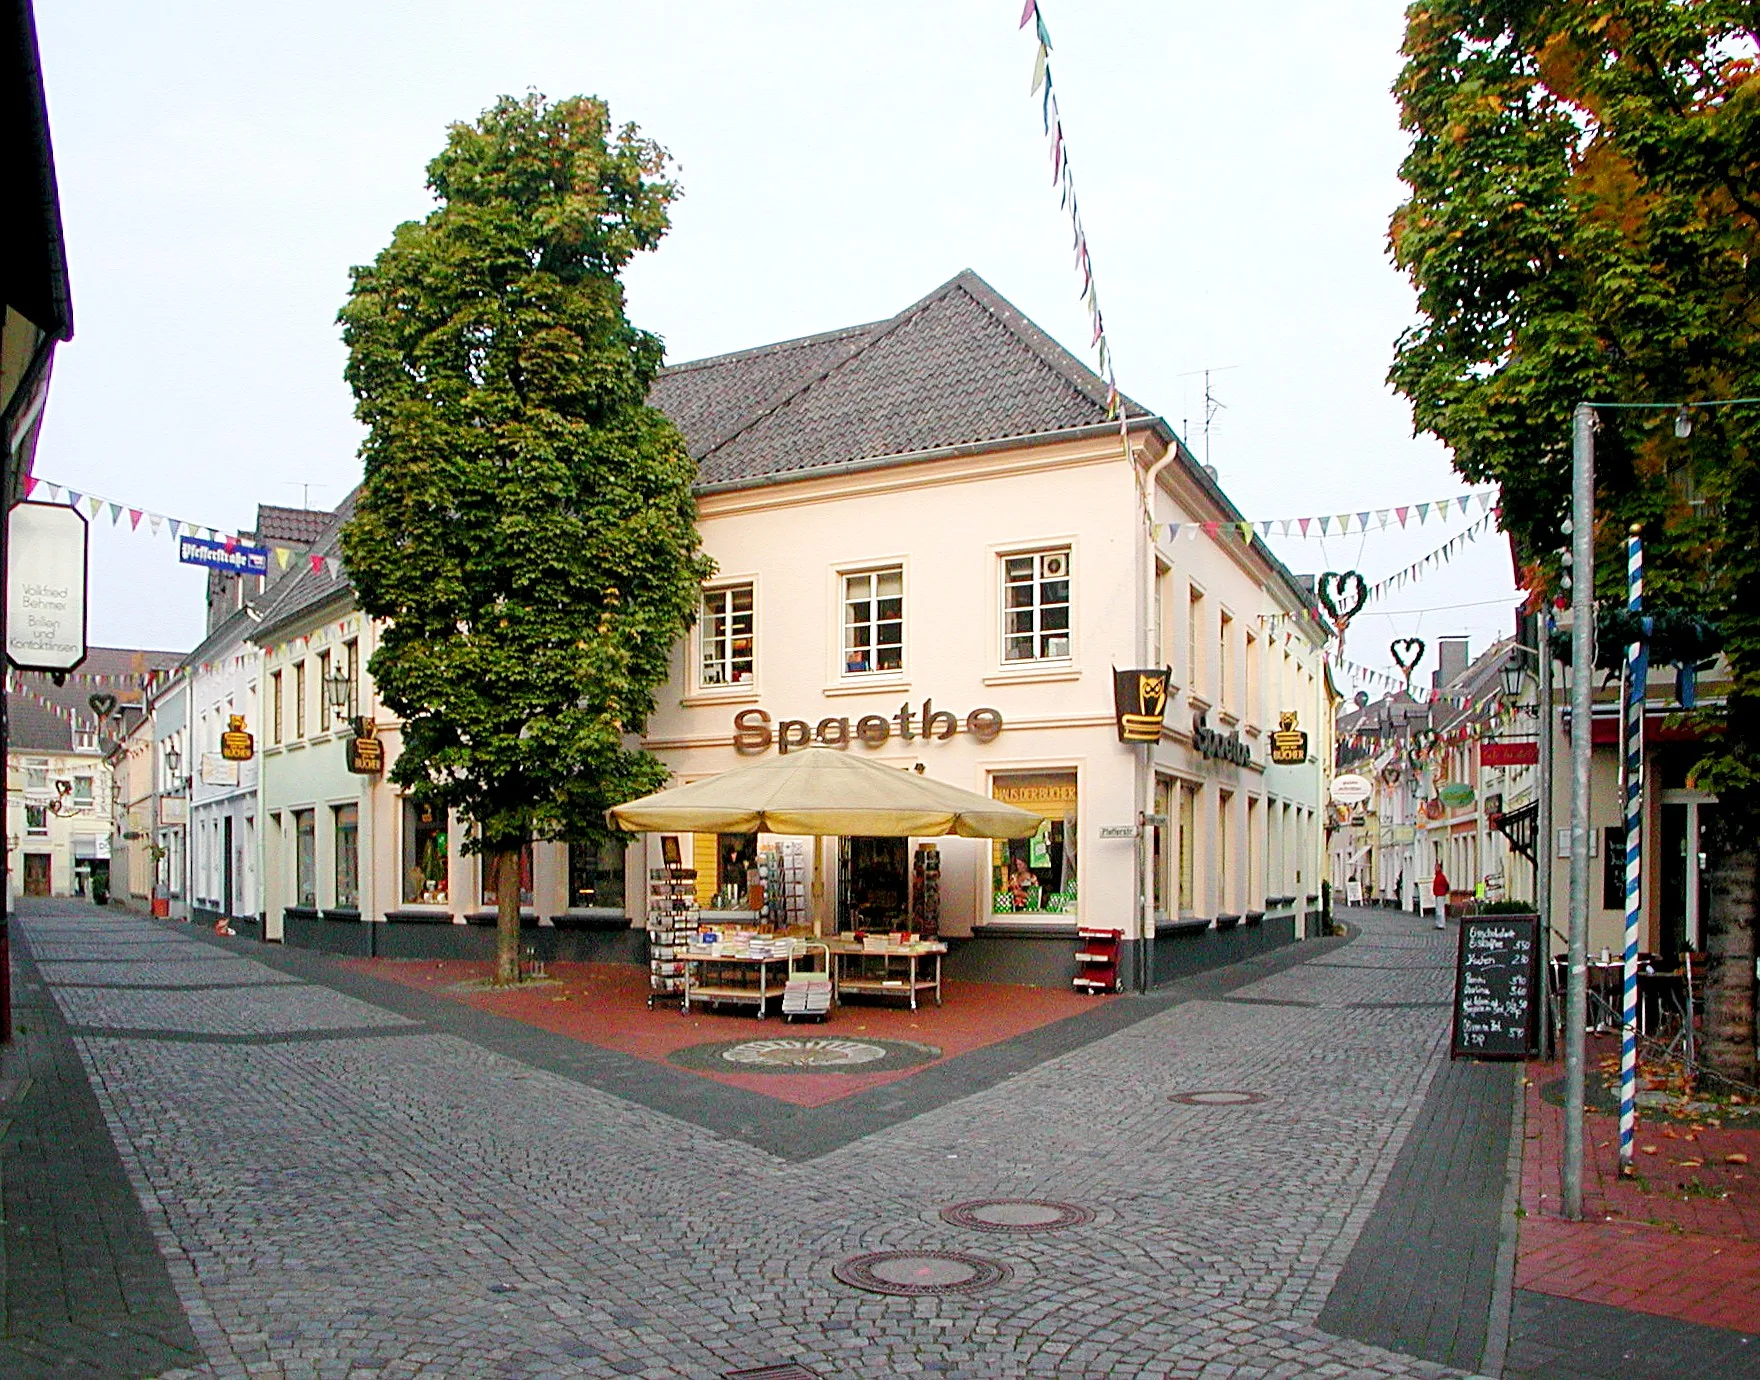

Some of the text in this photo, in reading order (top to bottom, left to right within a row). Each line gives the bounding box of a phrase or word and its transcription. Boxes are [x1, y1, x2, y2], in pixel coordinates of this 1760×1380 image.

[22, 583, 68, 598] Volkfried
[22, 596, 67, 610] Behmer
[28, 615, 60, 628] Brillen
[33, 627, 56, 639] und
[10, 637, 78, 653] Kontaktlinsen
[733, 698, 1004, 754] Spaethe
[1192, 711, 1251, 767] Spaethe
[995, 787, 1018, 801] HAUS
[1019, 787, 1038, 801] DER
